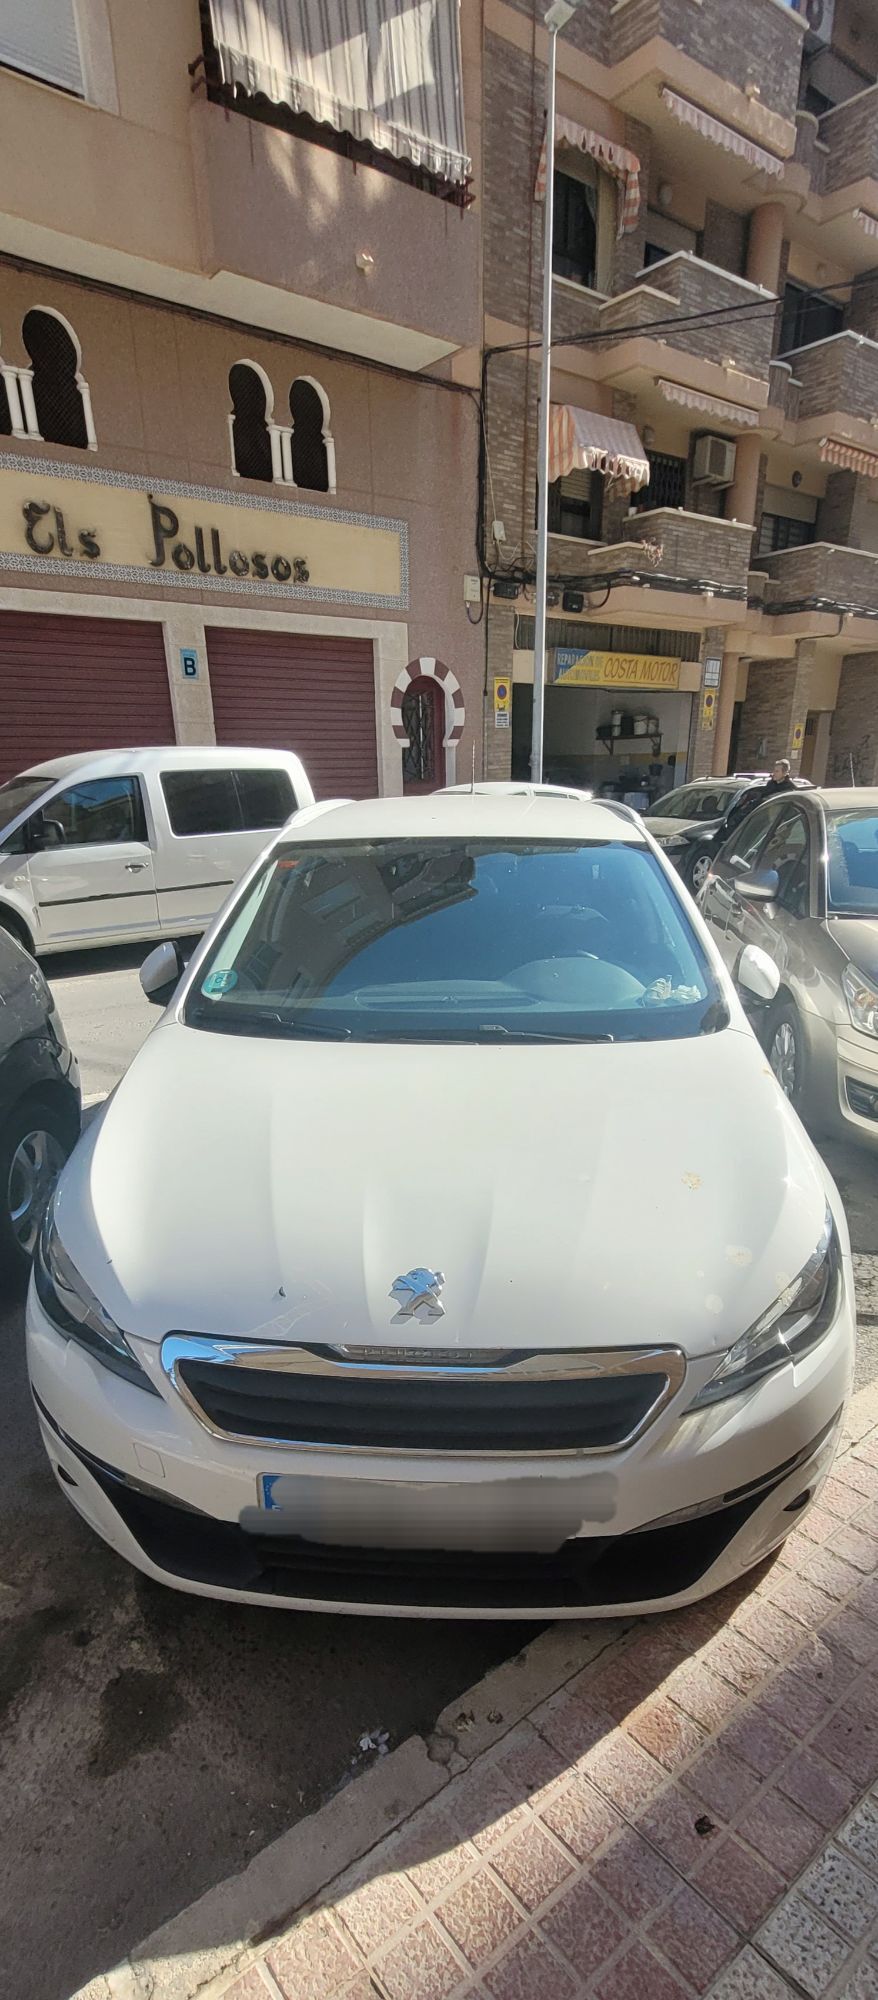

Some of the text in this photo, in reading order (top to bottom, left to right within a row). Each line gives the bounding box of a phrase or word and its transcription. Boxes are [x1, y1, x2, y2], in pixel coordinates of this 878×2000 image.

[22, 493, 311, 583] Els Pollosos
[183, 657, 196, 676] B
[603, 657, 639, 679] COSTA
[640, 661, 678, 682] MOTOR
